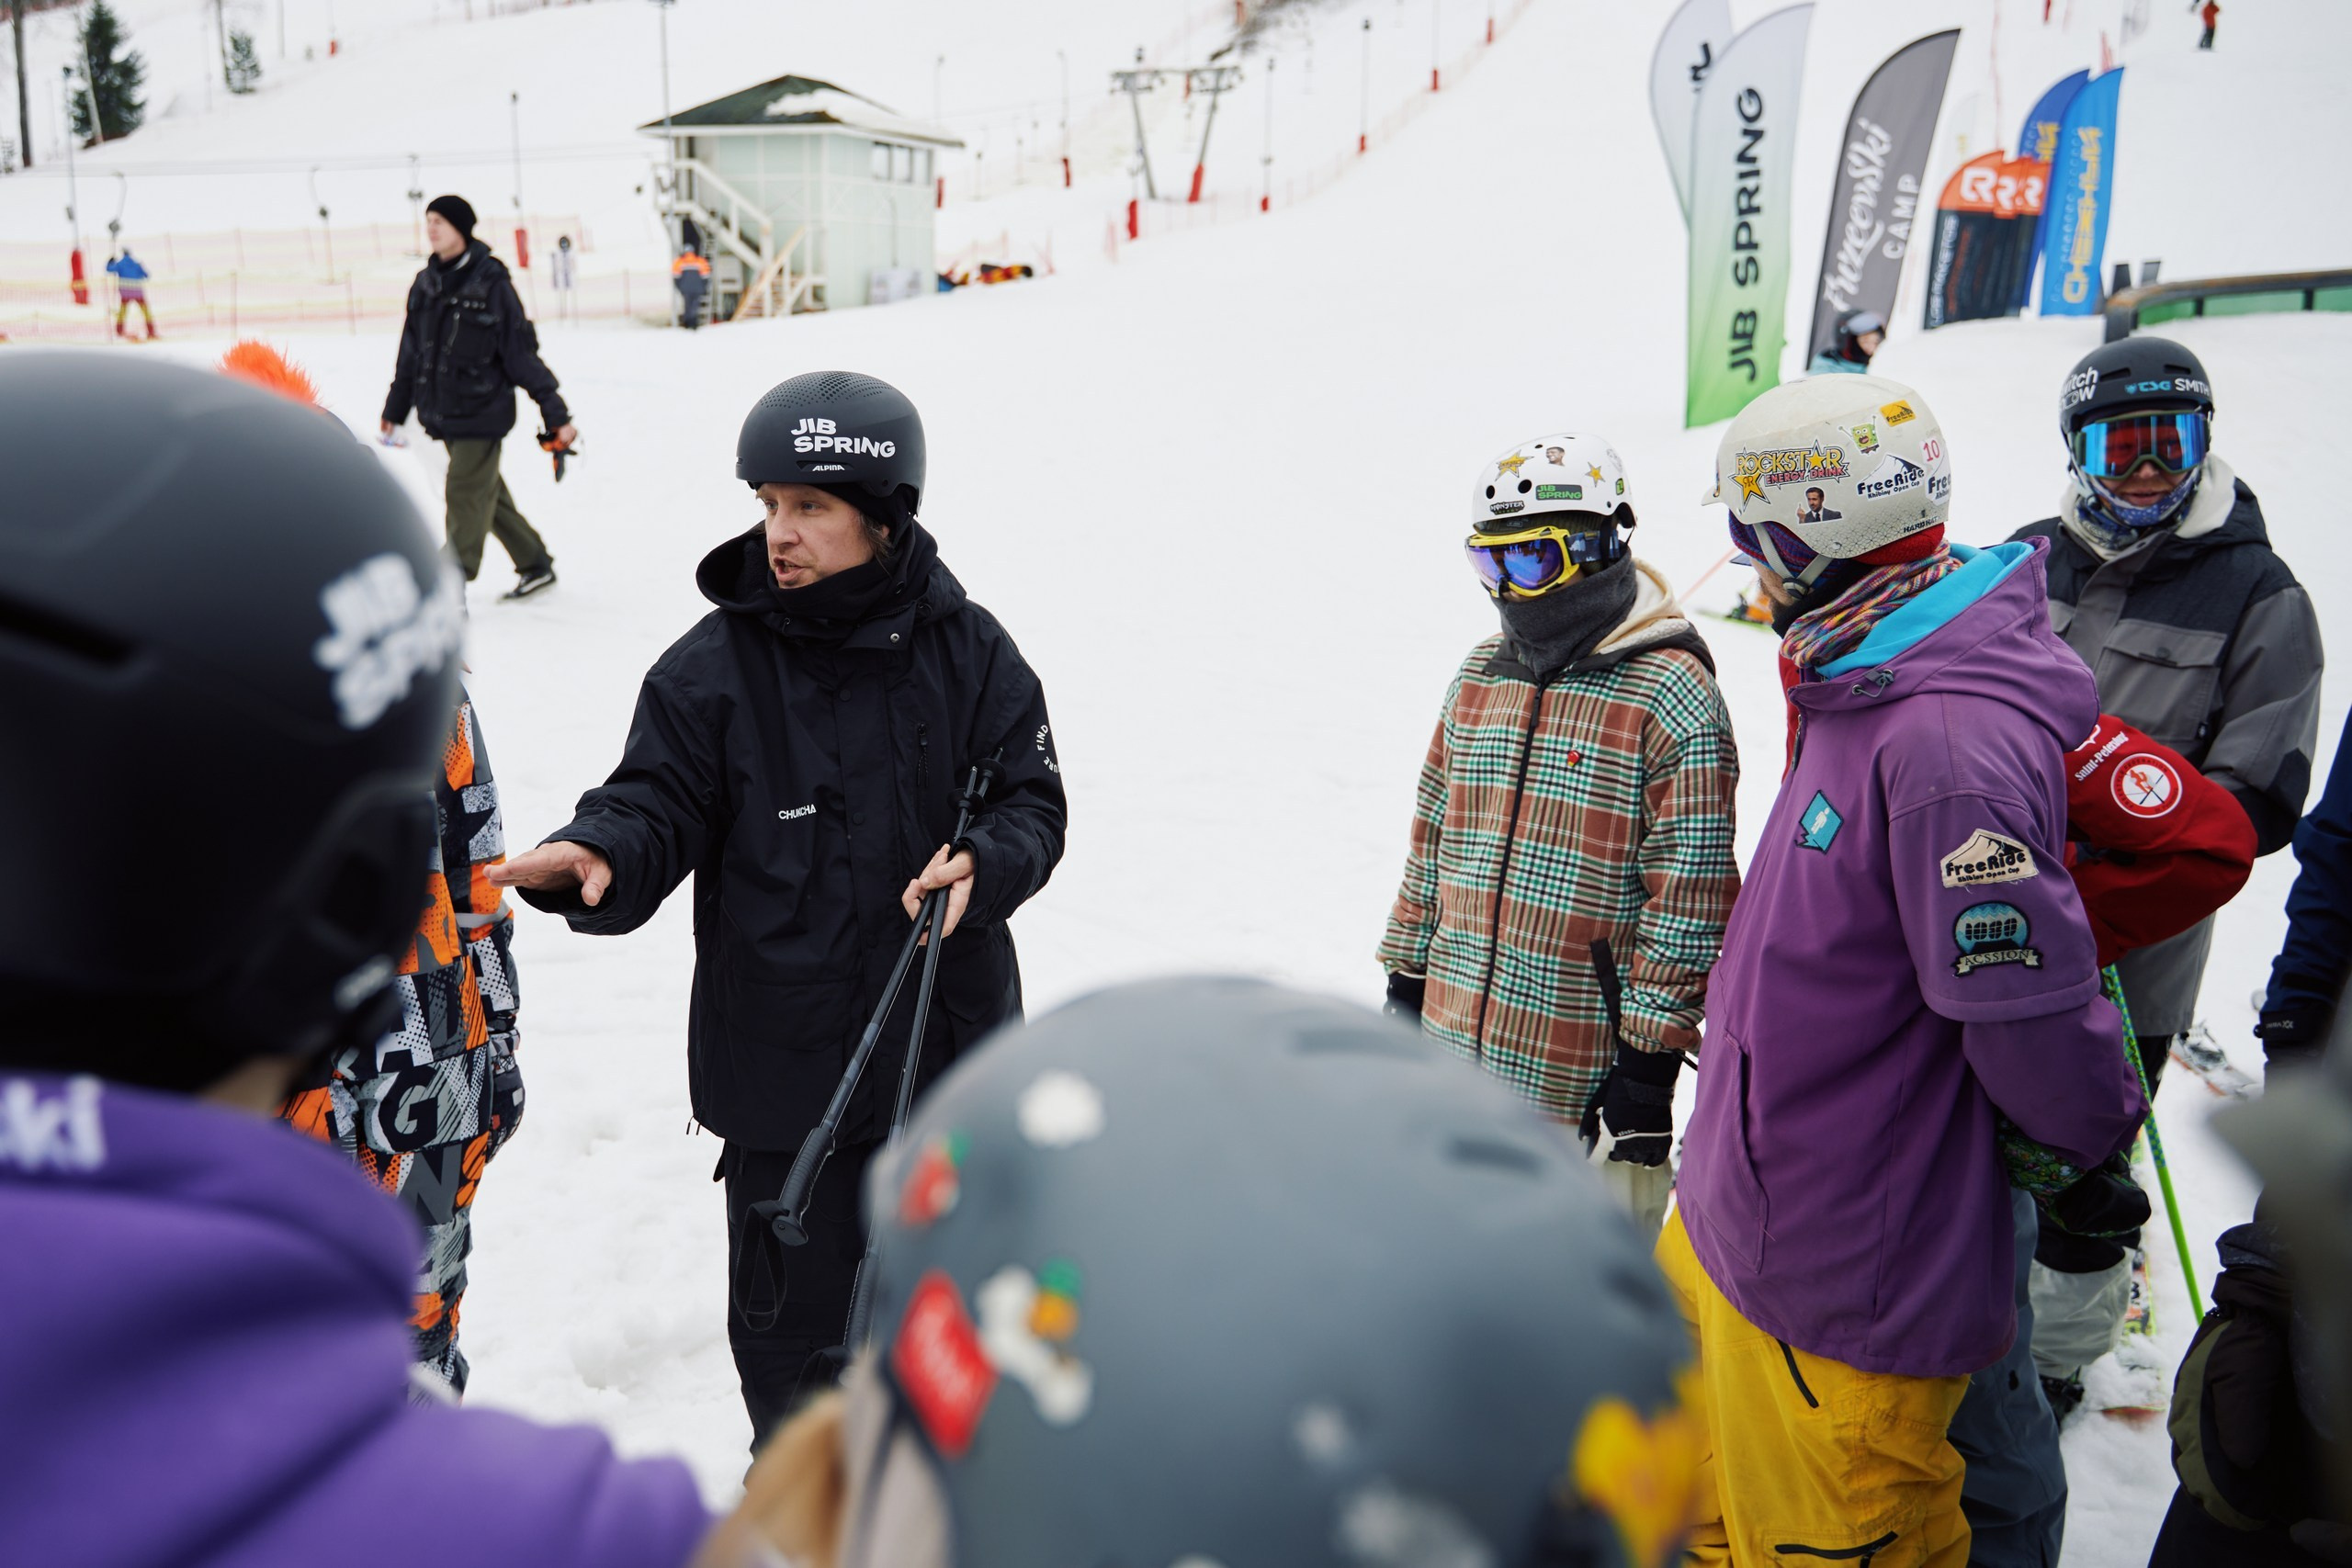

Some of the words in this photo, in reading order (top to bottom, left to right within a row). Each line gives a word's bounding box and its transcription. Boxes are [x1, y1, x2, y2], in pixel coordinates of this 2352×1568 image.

[1733, 87, 1765, 288] SPRING
[1883, 174, 1919, 259] CAMP
[1727, 309, 1758, 383] JIB
[2174, 378, 2209, 397] SMITH
[791, 418, 837, 436] JIB
[794, 435, 896, 458] SPRING
[1923, 440, 1939, 462] 10
[812, 464, 845, 472] ALPINA
[1765, 468, 1806, 485] ENERGY
[1810, 466, 1846, 479] DRINK
[1857, 468, 1925, 494] FreeRide
[1036, 725, 1048, 750] FIND
[778, 804, 817, 820] CHUKCHA
[1985, 870, 2007, 879] Open
